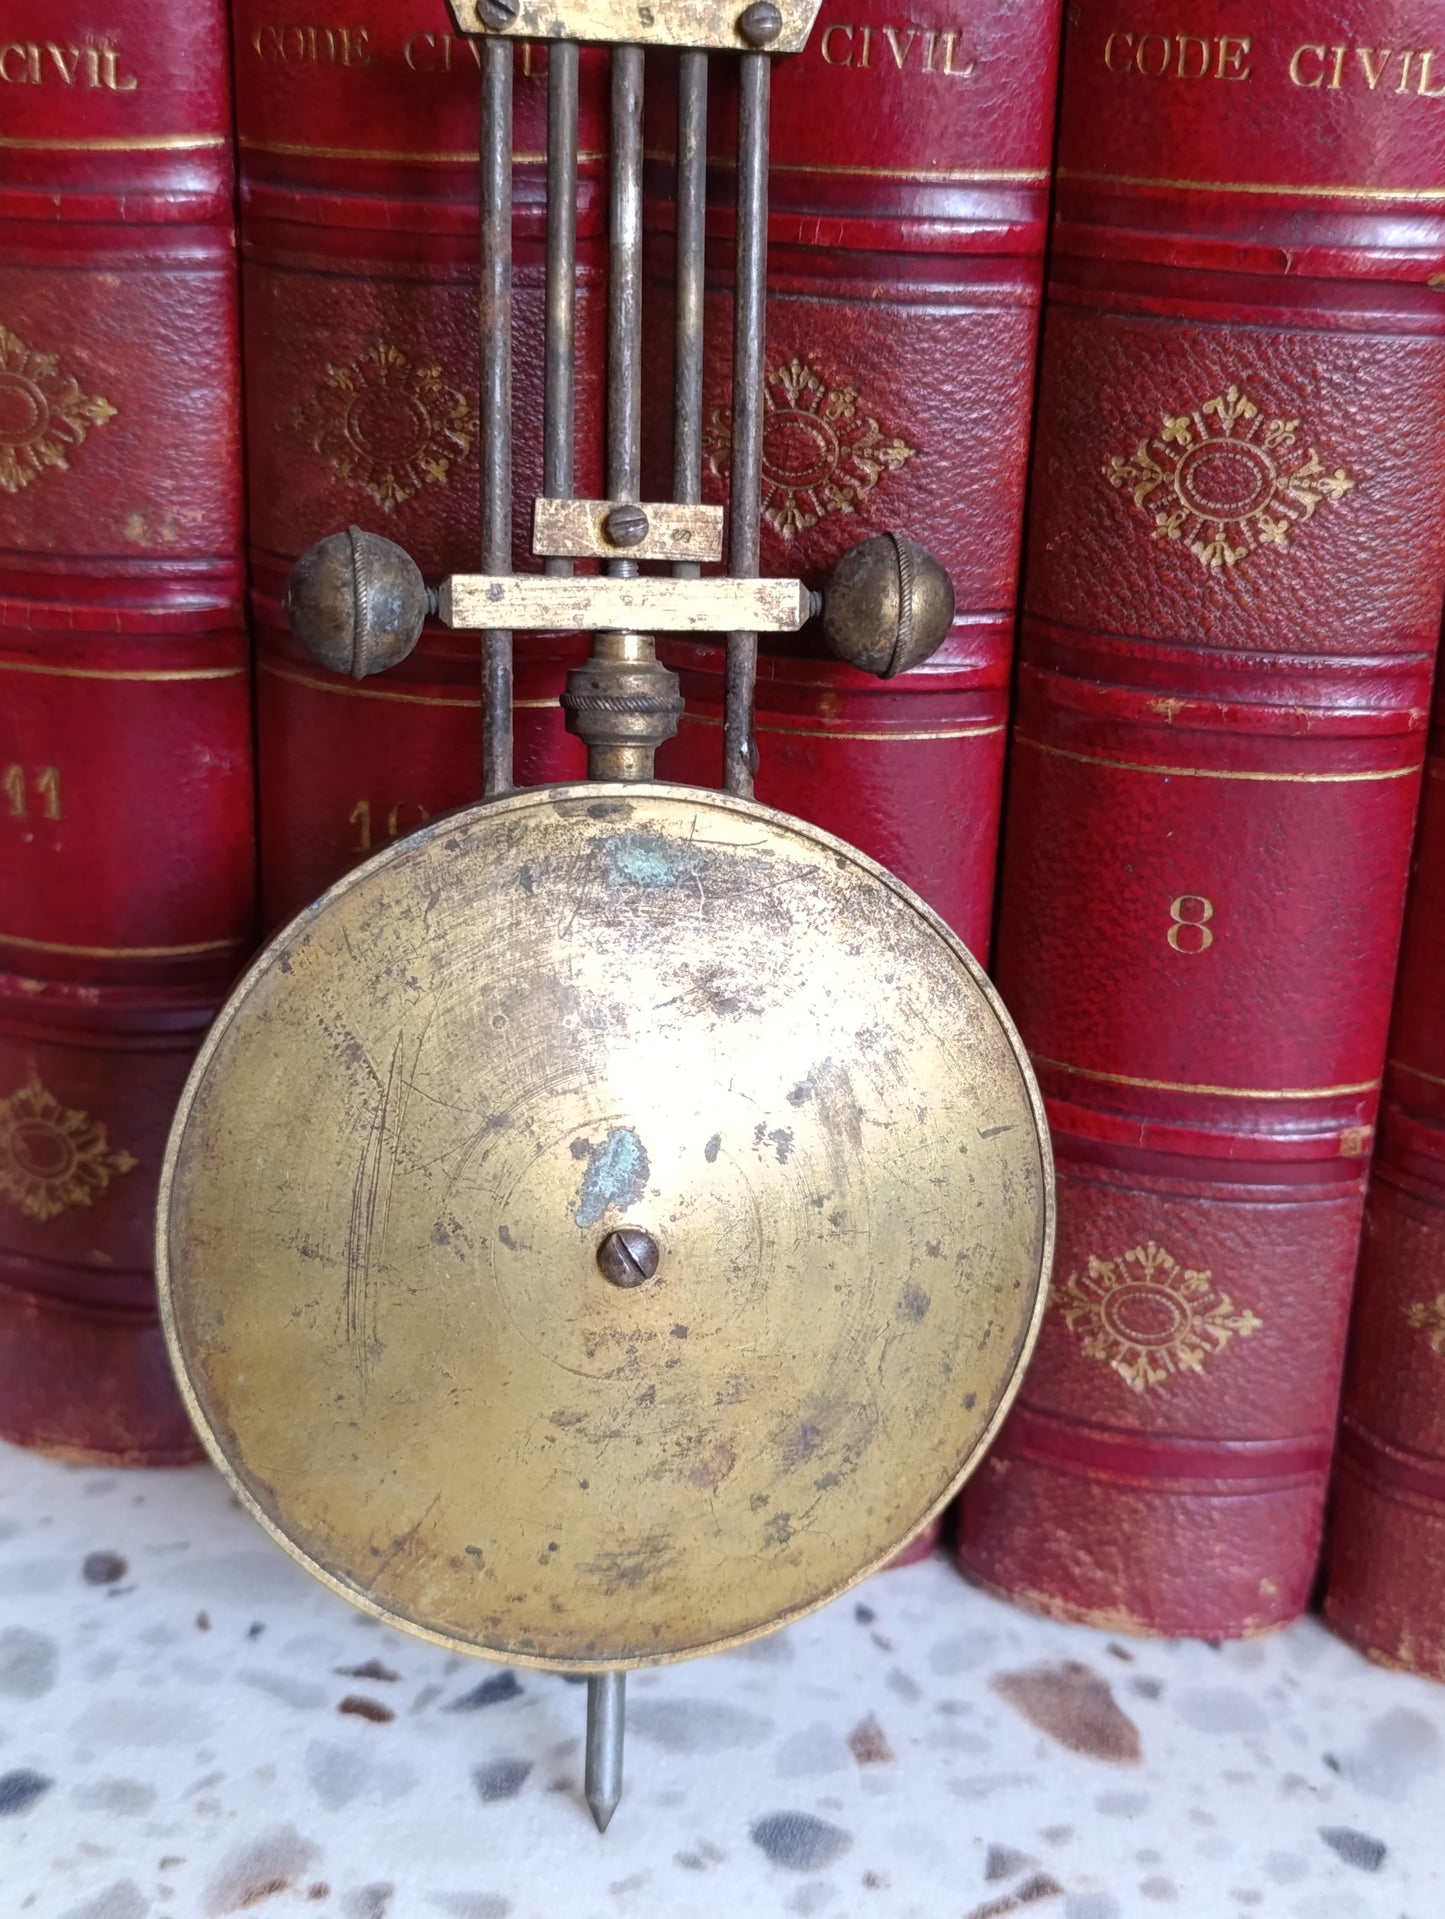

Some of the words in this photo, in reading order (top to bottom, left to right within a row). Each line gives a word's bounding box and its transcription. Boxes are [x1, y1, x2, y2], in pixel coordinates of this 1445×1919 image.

[0, 43, 138, 90] CIVIL
[252, 25, 371, 66] CODE
[404, 33, 548, 77] CIVL
[821, 24, 975, 77] CIVIL
[1104, 32, 1251, 81] CODE
[1289, 43, 1445, 97] CIVIL
[4, 764, 65, 820] 11
[1167, 894, 1214, 955] 8
